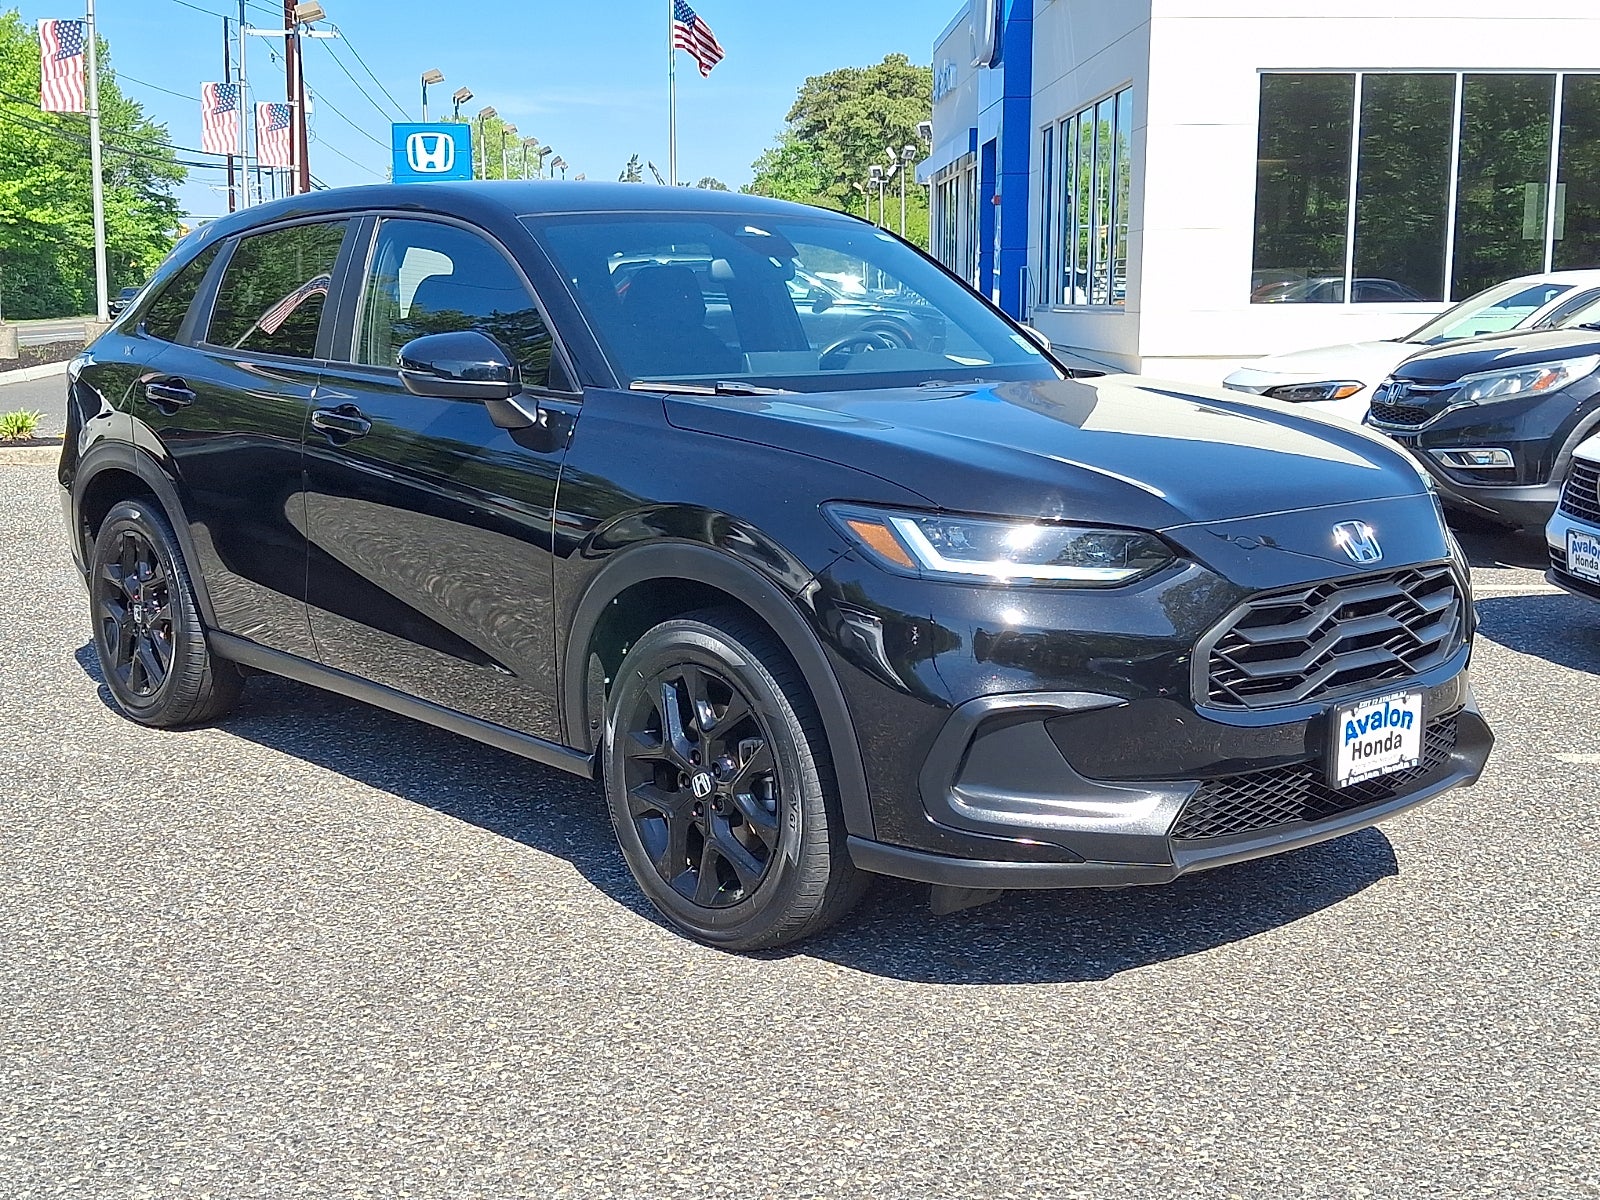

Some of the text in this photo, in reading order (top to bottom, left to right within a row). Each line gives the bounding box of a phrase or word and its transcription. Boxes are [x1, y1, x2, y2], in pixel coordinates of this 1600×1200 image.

[1575, 553, 1599, 570] Honda
[1345, 702, 1413, 747] Avalon
[1352, 731, 1403, 761] Honda
